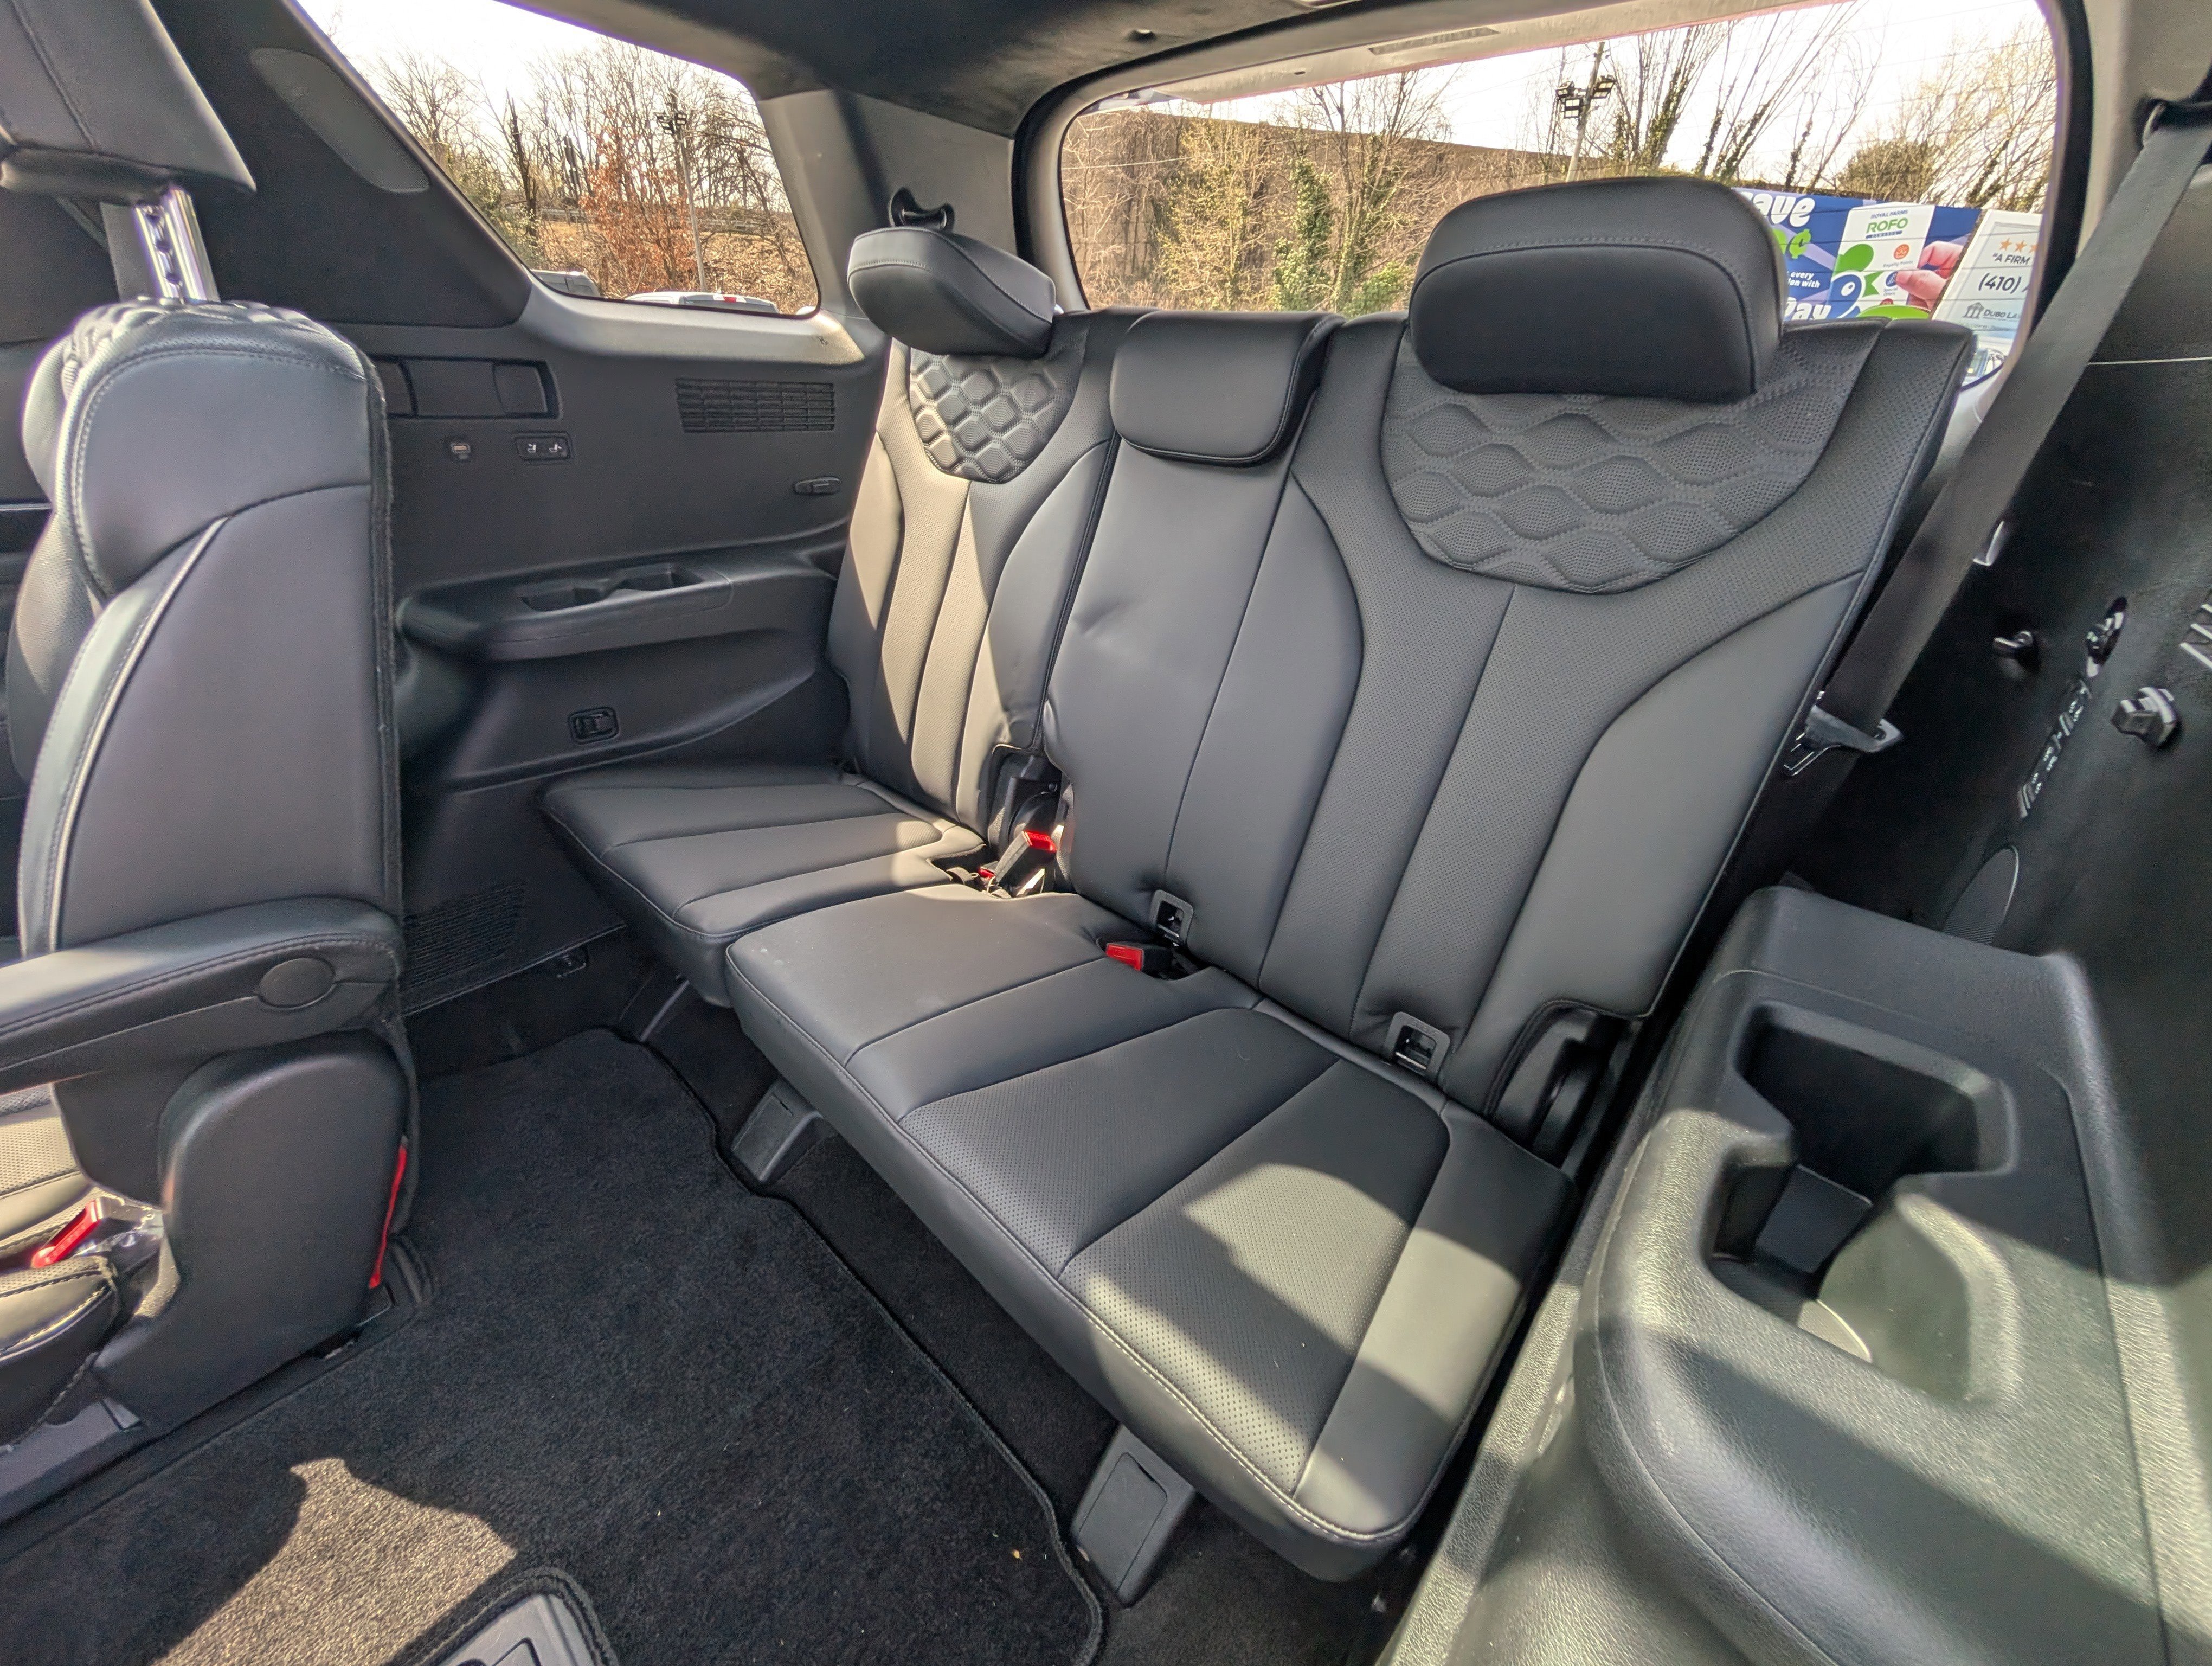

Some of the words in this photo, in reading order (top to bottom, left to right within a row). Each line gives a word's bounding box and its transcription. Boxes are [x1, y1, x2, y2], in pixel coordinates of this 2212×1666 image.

[1866, 217, 1908, 234] ROFO
[2004, 254, 2030, 265] FIRM
[1790, 271, 1815, 280] every
[1801, 280, 1821, 289] with
[1978, 273, 2022, 294] (410)
